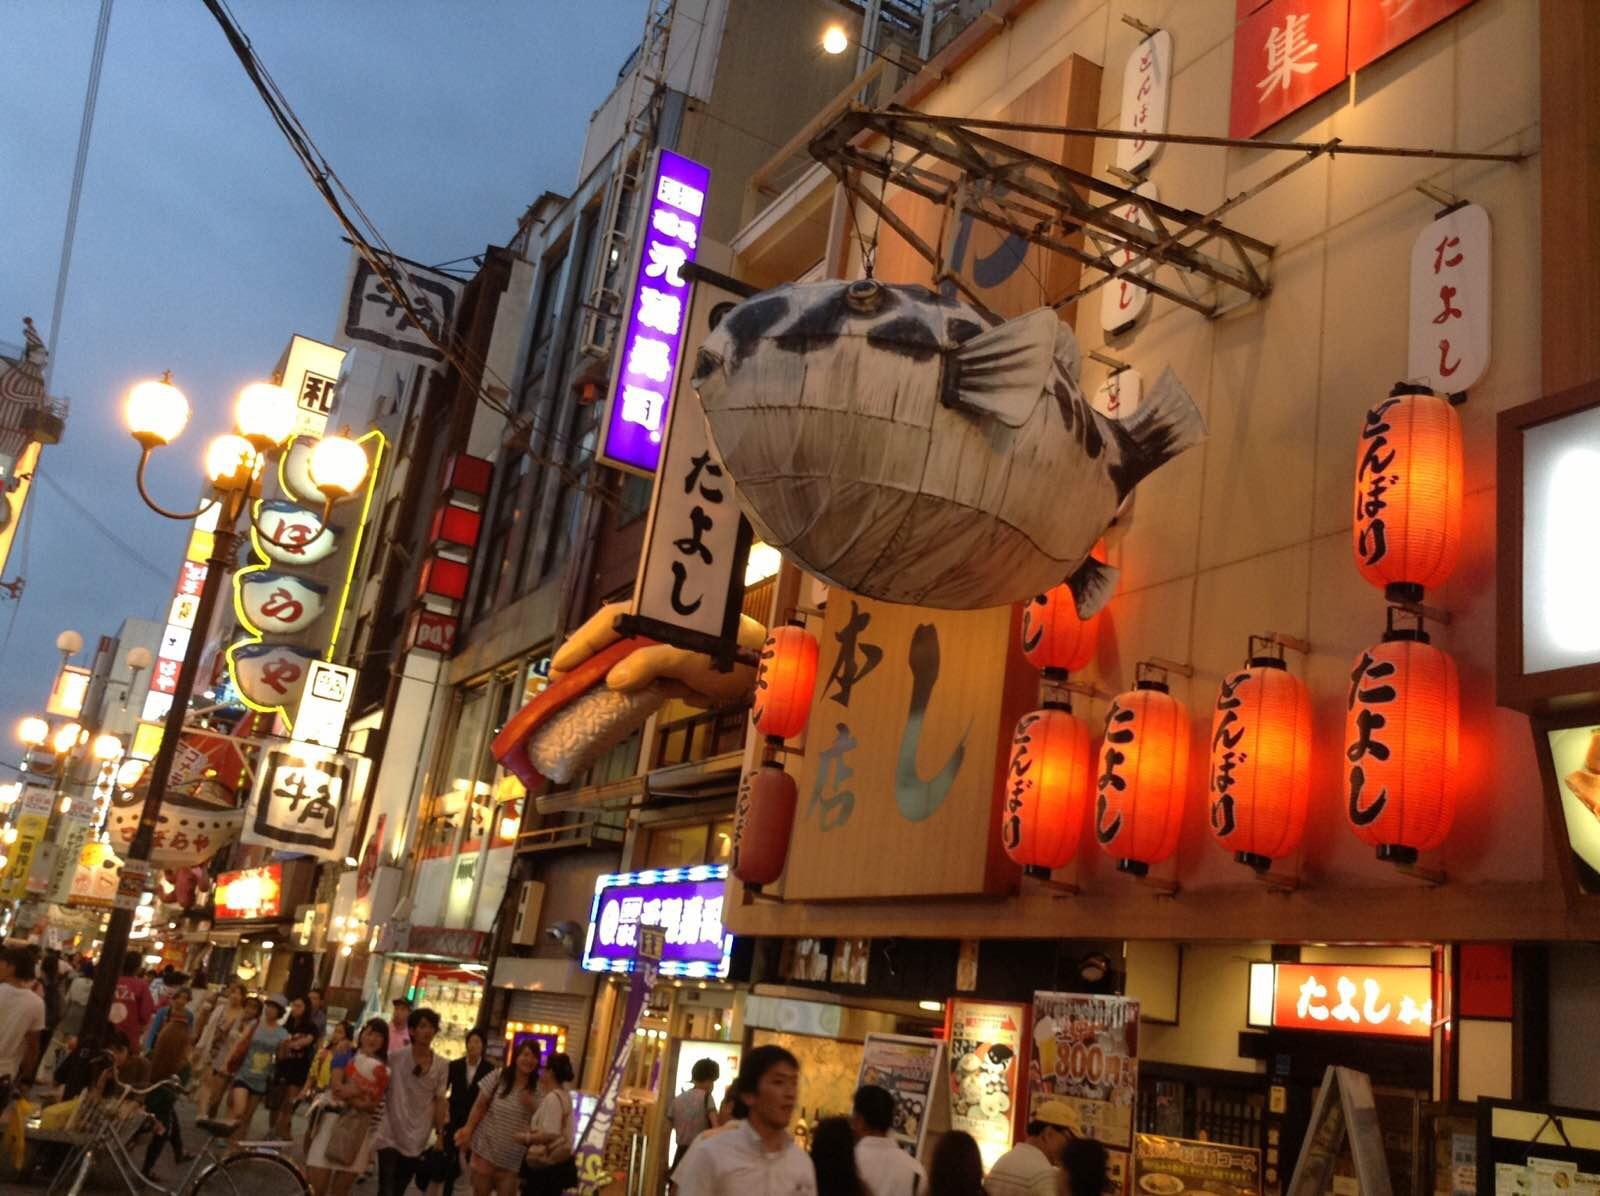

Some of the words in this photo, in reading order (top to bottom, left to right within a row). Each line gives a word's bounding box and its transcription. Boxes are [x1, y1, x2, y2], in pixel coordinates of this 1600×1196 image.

[1432, 235, 1465, 377] たよし
[670, 449, 724, 616] たよし
[273, 771, 336, 829] 牛角
[1096, 700, 1135, 845] たよし
[1346, 652, 1397, 827] たよし
